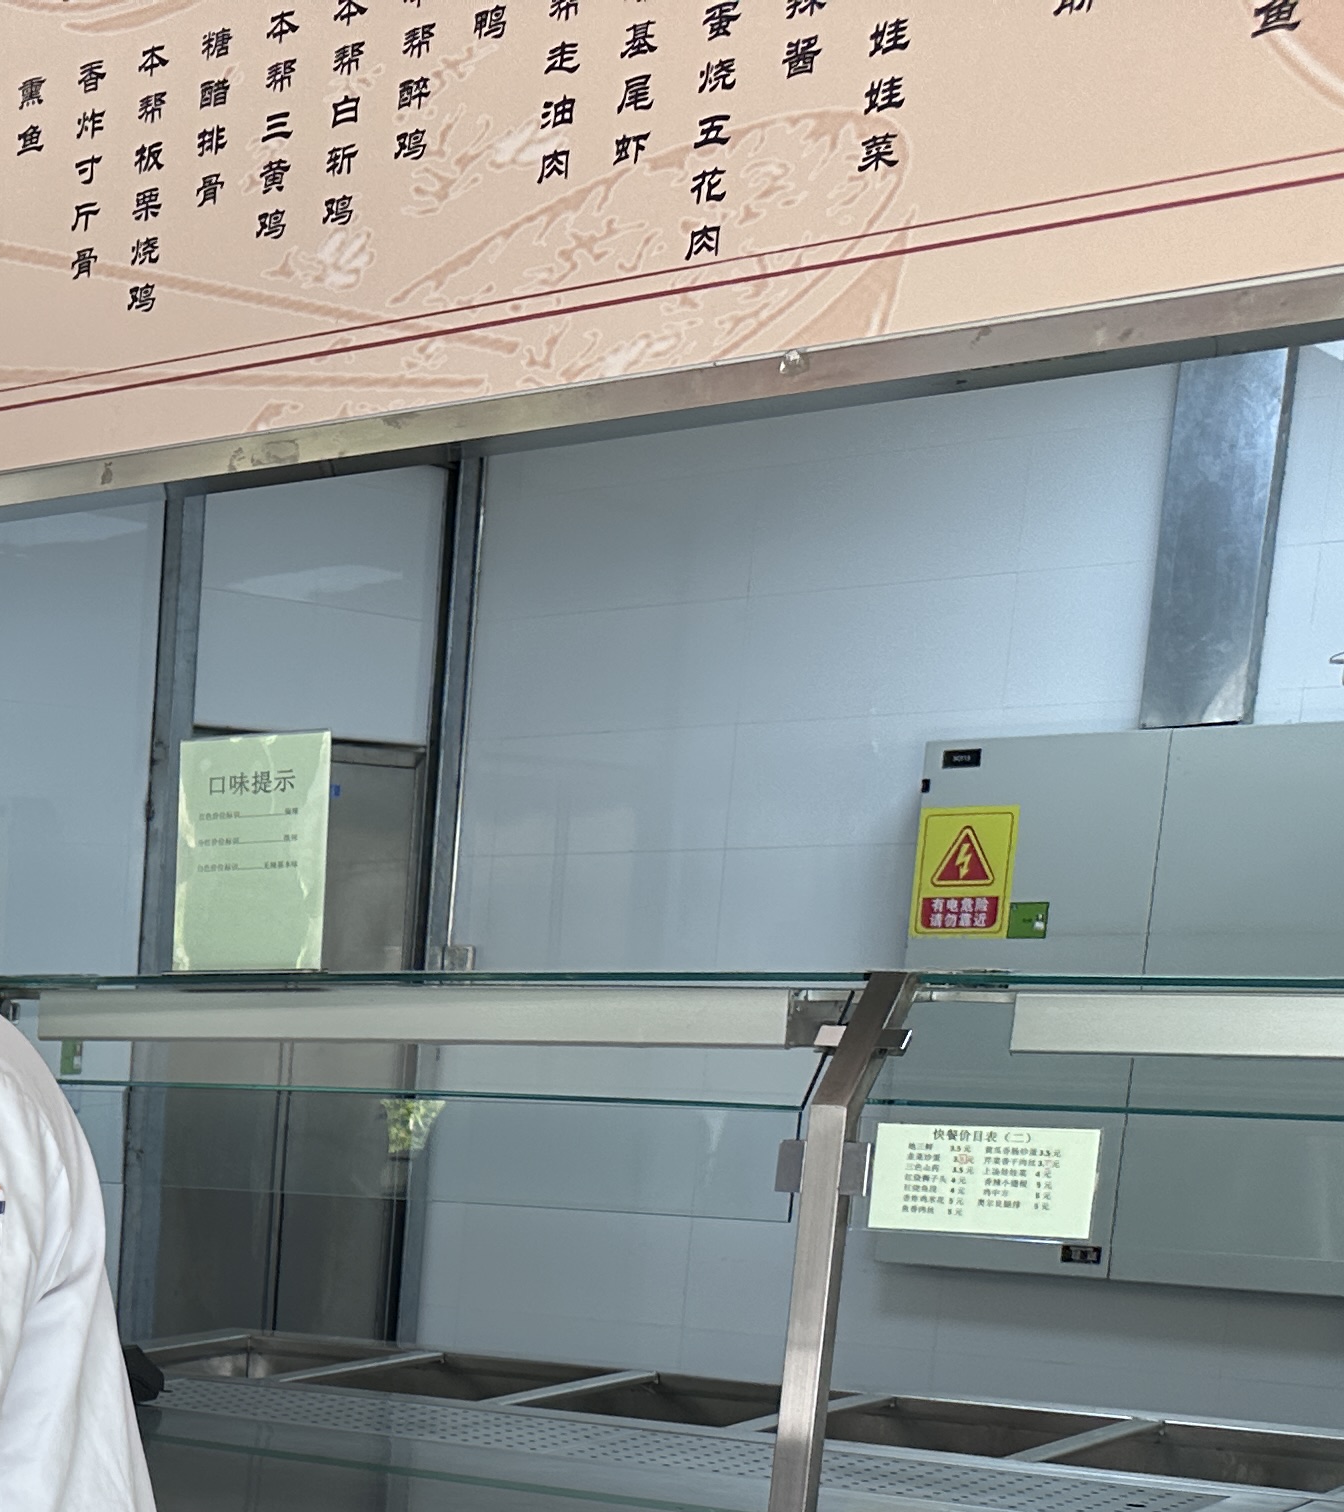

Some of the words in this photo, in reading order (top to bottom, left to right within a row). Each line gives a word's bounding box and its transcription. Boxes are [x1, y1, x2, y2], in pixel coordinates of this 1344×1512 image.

[393, 0, 436, 161] 帮醉鸡
[473, 4, 507, 40] 鸭
[612, 0, 658, 166] 基尾虾
[857, 18, 911, 172] 娃娃菜
[16, 76, 46, 157] 熏鱼
[71, 60, 107, 280] 香炸寸斤骨
[127, 45, 170, 313] 本帮板栗烧鸡
[195, 27, 233, 208] 糖醋排骨
[255, 10, 300, 240] 本帮三黄鸡
[322, 0, 369, 226] 本帮白斩鸡
[684, 0, 742, 270] 蛋烧五花肉
[209, 768, 296, 796] 口味提示
[930, 913, 987, 928] 请勿靠近
[931, 897, 989, 913] 有电危险
